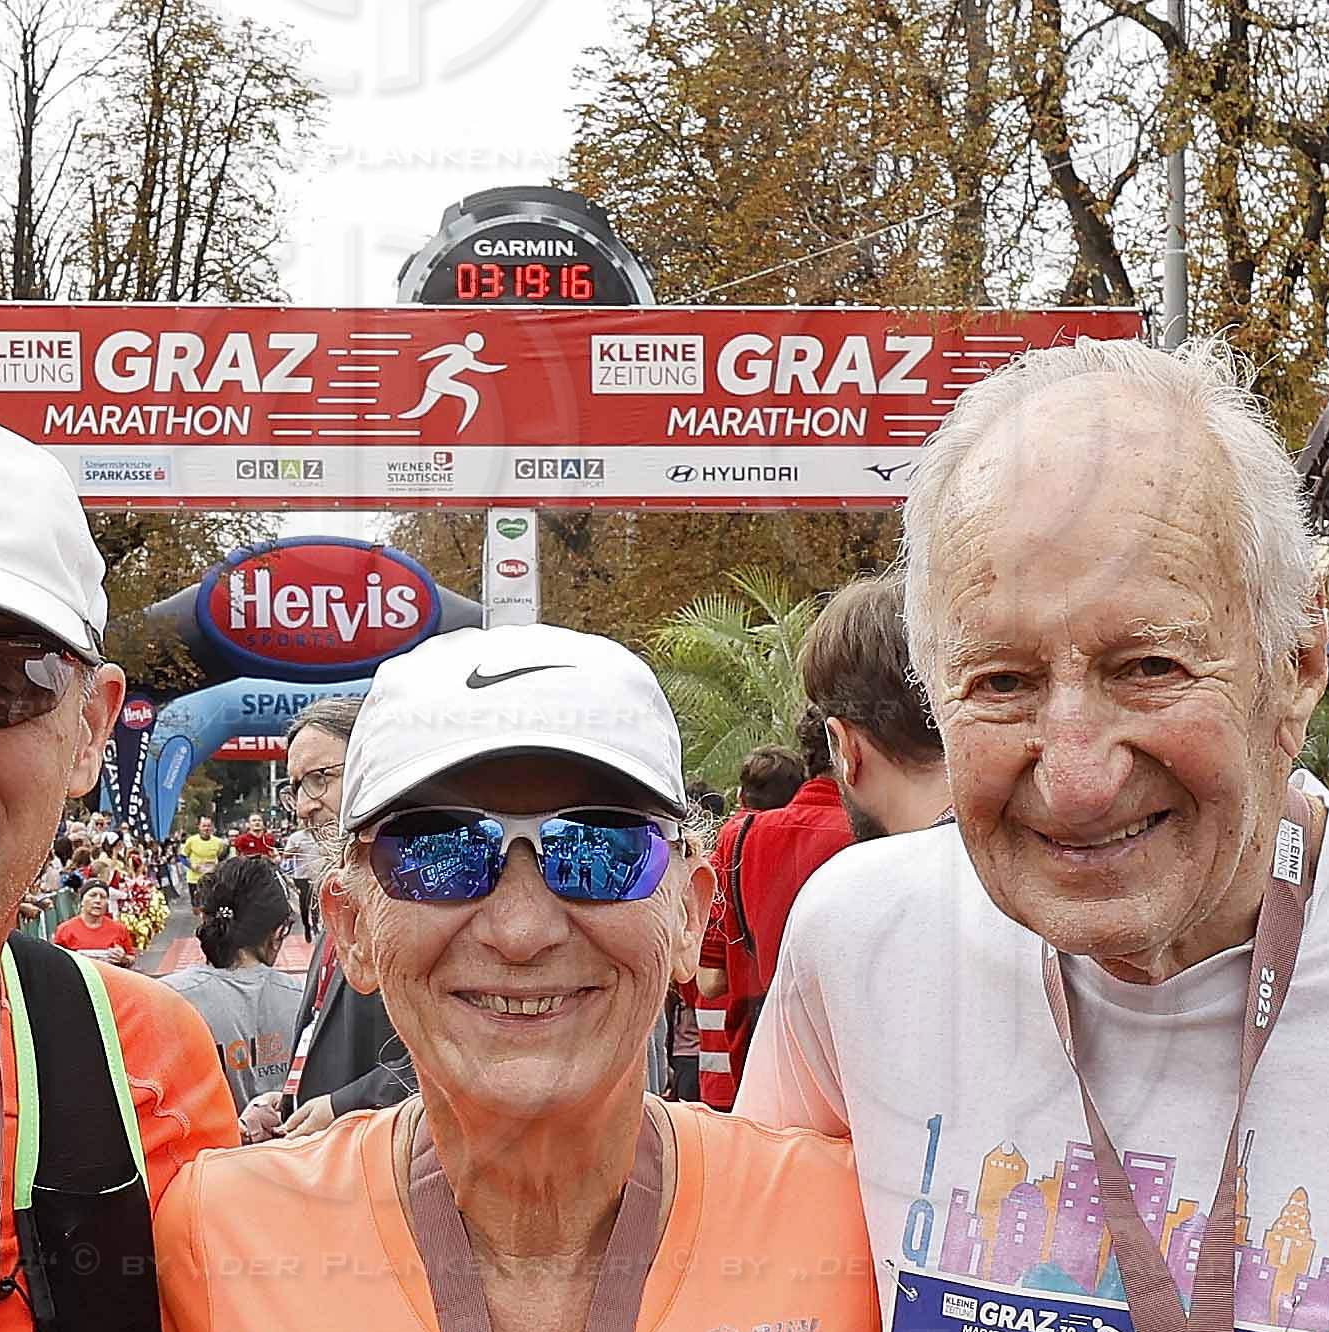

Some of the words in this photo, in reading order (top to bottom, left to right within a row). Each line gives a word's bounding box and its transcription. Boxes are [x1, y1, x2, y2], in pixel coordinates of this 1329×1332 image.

[474, 238, 573, 257] GARMIN
[94, 331, 318, 393] GRAZ
[598, 343, 697, 362] KLEINE
[717, 334, 933, 394] GRAZ
[598, 366, 698, 386] ZEITUNG
[43, 404, 251, 437] MARATHON
[666, 407, 866, 437] MARATHON
[85, 470, 153, 482] SPARKASSE
[238, 461, 322, 479] GRAZ
[387, 461, 432, 472] WIENER
[516, 459, 603, 479] GRAZ
[702, 466, 799, 482] HYUNDAI
[229, 568, 420, 647] Hervis
[1276, 820, 1289, 876] ZEITUNG
[1287, 827, 1302, 881] KLEINE
[1254, 968, 1275, 1030] 2023
[945, 1304, 975, 1318] ZEITUNG
[946, 1296, 975, 1309] KLEINE
